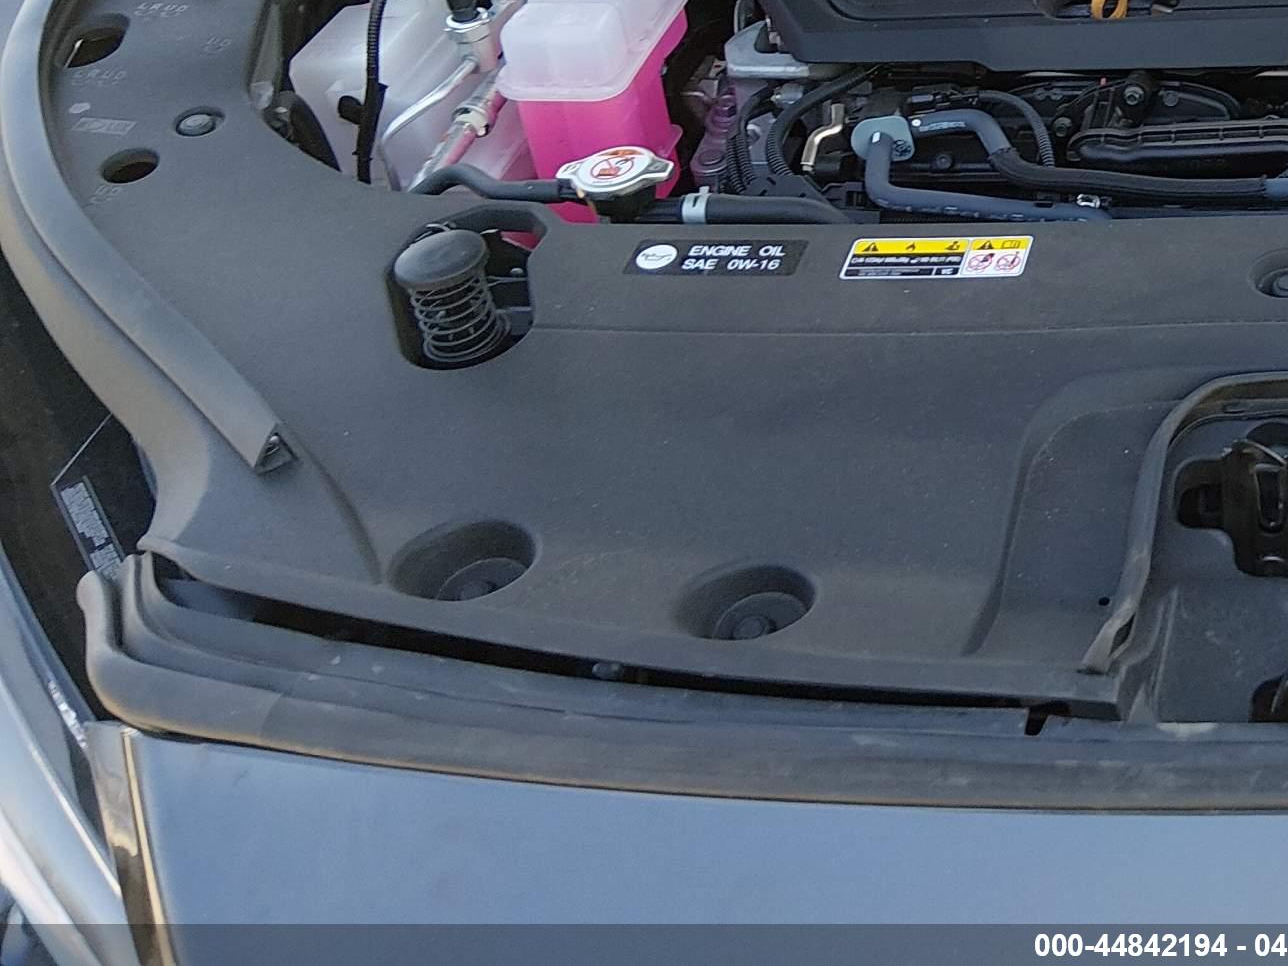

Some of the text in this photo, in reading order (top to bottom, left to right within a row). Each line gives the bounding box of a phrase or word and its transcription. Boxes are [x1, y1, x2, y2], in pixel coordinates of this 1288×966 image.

[688, 245, 786, 257] ENGINE OIL
[681, 258, 781, 271] SAE 0W-16
